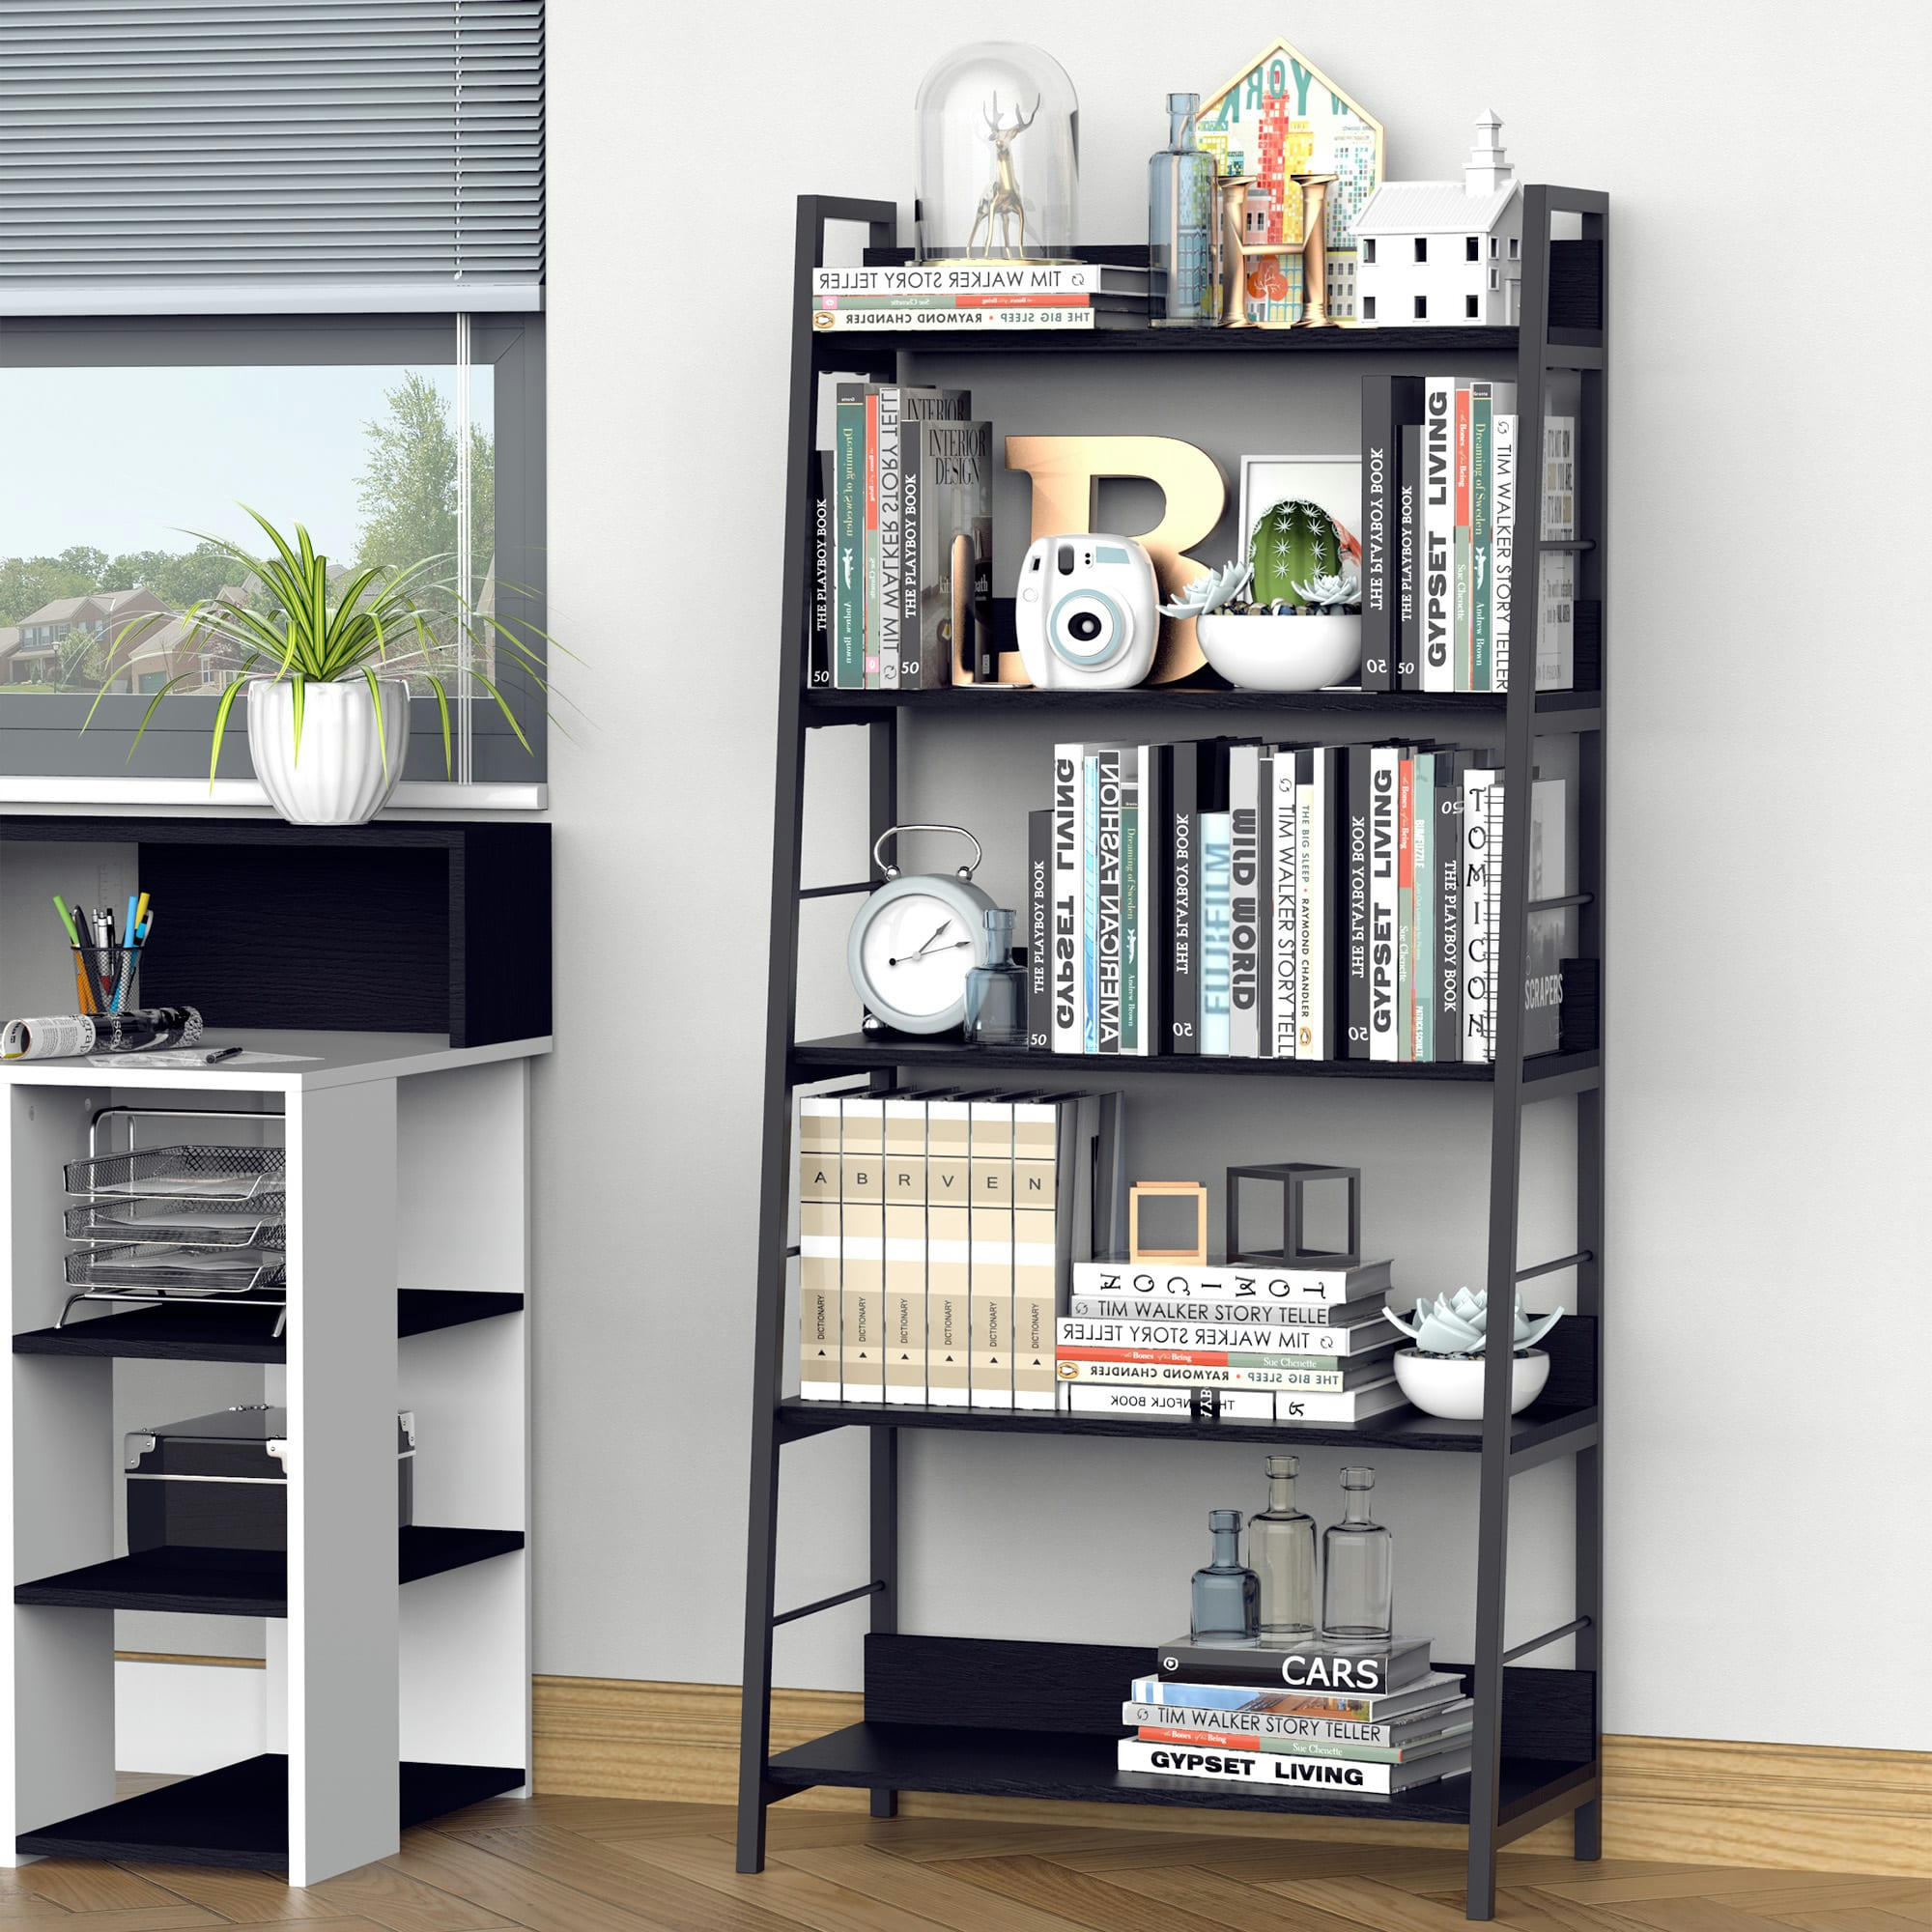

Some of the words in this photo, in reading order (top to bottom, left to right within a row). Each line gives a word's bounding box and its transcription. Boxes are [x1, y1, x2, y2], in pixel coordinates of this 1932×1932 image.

[929, 429, 985, 457] INTERIOR
[1429, 392, 1447, 505] LIVING
[1473, 423, 1486, 476] Dreaming
[1497, 444, 1512, 475] TIM
[935, 457, 980, 485] DESIGN
[1475, 479, 1486, 491] of
[905, 474, 917, 515] BOOK
[1402, 486, 1411, 525] BOOK
[817, 498, 827, 537] BOOK
[1475, 493, 1486, 535] Sweden
[1497, 482, 1513, 557] WALKER
[905, 517, 917, 584] PLAYBOY
[1402, 528, 1411, 591] PLAYBOY
[817, 540, 827, 602] PLAYBOY
[1457, 564, 1465, 580] Sue
[905, 588, 917, 618] THE
[1402, 595, 1411, 621] THE
[1429, 531, 1447, 668] GYPSET
[1496, 565, 1511, 628] STORY
[817, 605, 827, 631] THE
[1475, 601, 1485, 635] Andrew
[901, 662, 919, 674] 50
[1398, 662, 1414, 674] 50
[1475, 639, 1485, 667] Brown
[1496, 631, 1509, 690] TELLER
[813, 670, 829, 682] 50
[1279, 805, 1294, 838] TIM
[1374, 770, 1391, 878] LIVING
[1127, 828, 1136, 871] Dreaming
[1233, 809, 1256, 886] WILD
[1035, 861, 1044, 898] BOOK
[1127, 873, 1135, 884] of
[1279, 847, 1294, 930] WALKER
[1445, 861, 1457, 890] THE
[1035, 901, 1044, 964] PLAYBOY
[1301, 898, 1310, 955] RAYMOND
[1445, 895, 1457, 966] PLAYBOY
[1233, 897, 1256, 1010] WORLD
[1279, 938, 1294, 1002] STORY
[1374, 902, 1391, 1033] GYPSET
[1035, 968, 1044, 994] THE
[1301, 960, 1310, 1017] CHANDLER
[1445, 970, 1457, 1011] BOOK
[1524, 974, 1563, 1010] SCRAPERS
[1031, 1034, 1046, 1046] 50
[1279, 1011, 1294, 1056] TELL
[814, 1172, 827, 1183] A
[857, 1173, 867, 1184] B
[899, 1174, 911, 1186] R
[942, 1176, 954, 1187] V
[987, 1177, 998, 1189] E
[1030, 1179, 1041, 1190] N
[1098, 1300, 1128, 1317] TIM
[1135, 1302, 1208, 1321] WALKER
[1215, 1305, 1273, 1322] STORY
[1171, 1353, 1192, 1363] Being
[1263, 1356, 1278, 1366] Sue
[1282, 1656, 1378, 1689] CARS
[1158, 1707, 1186, 1724] TIM
[1193, 1710, 1260, 1732] WALKER
[1266, 1718, 1321, 1737] STORY
[1325, 1722, 1380, 1742] TELLER
[1172, 1731, 1191, 1740] Bones
[1208, 1735, 1227, 1745] Being
[1293, 1743, 1307, 1752] Sue
[1309, 1744, 1343, 1756] Chenette
[1151, 1751, 1256, 1776] GYPSET
[1274, 1762, 1364, 1786] LIVING
